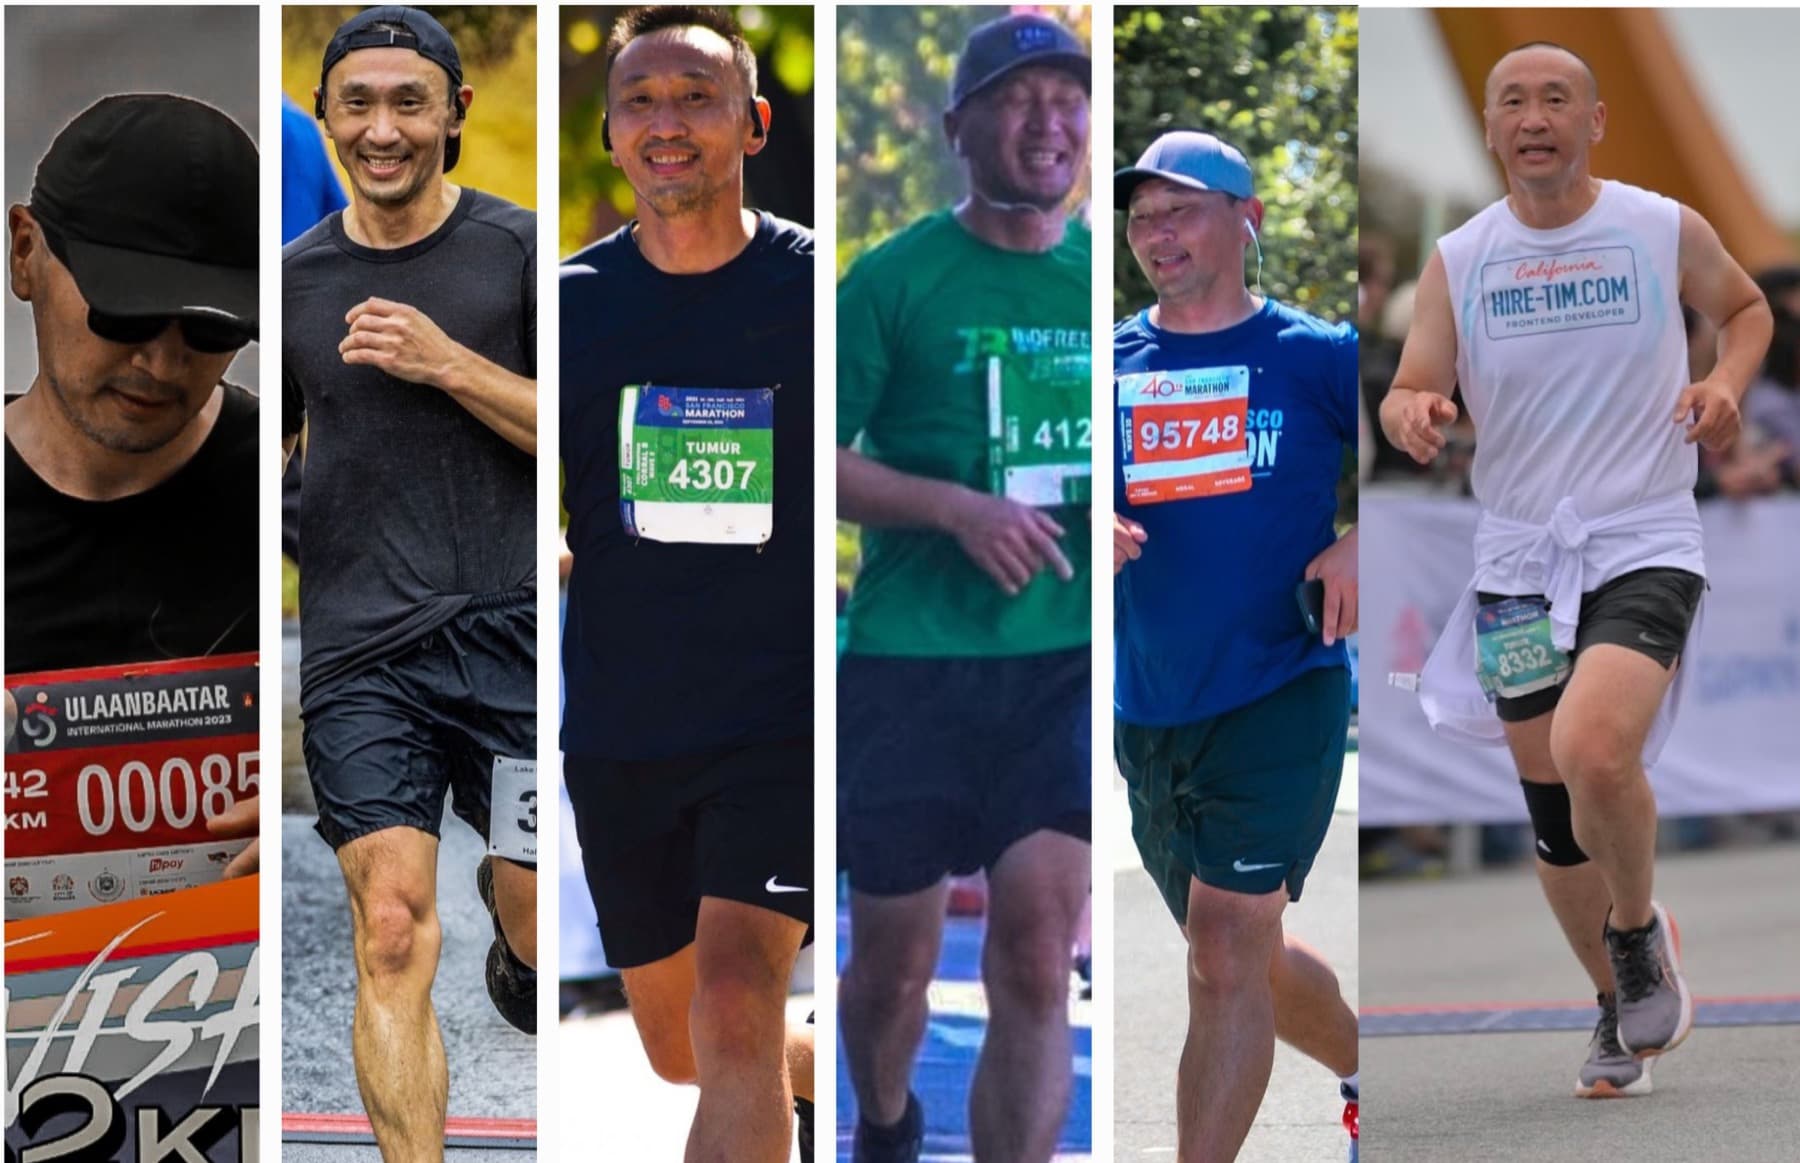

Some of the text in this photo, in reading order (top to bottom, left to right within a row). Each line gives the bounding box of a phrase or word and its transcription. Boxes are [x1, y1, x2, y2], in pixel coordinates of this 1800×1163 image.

[1515, 258, 1603, 281] California
[1491, 275, 1629, 318] HIRE-TIM.COM
[1506, 307, 1625, 329] FRONTEND DEVELOPER
[1184, 381, 1230, 395] MARATHON
[685, 409, 745, 418] MARATHON
[1033, 417, 1091, 449] 412
[1140, 414, 1239, 451] 95748
[685, 441, 741, 455] TUMUR
[668, 459, 757, 490] 4307
[1498, 644, 1552, 677] 8332
[65, 685, 230, 722] ULAANBAATAR
[67, 713, 232, 737] INTERNATIONAL MARATHON 2023
[514, 765, 534, 773] Lake
[4, 768, 49, 799] 42
[4, 811, 47, 830] KM
